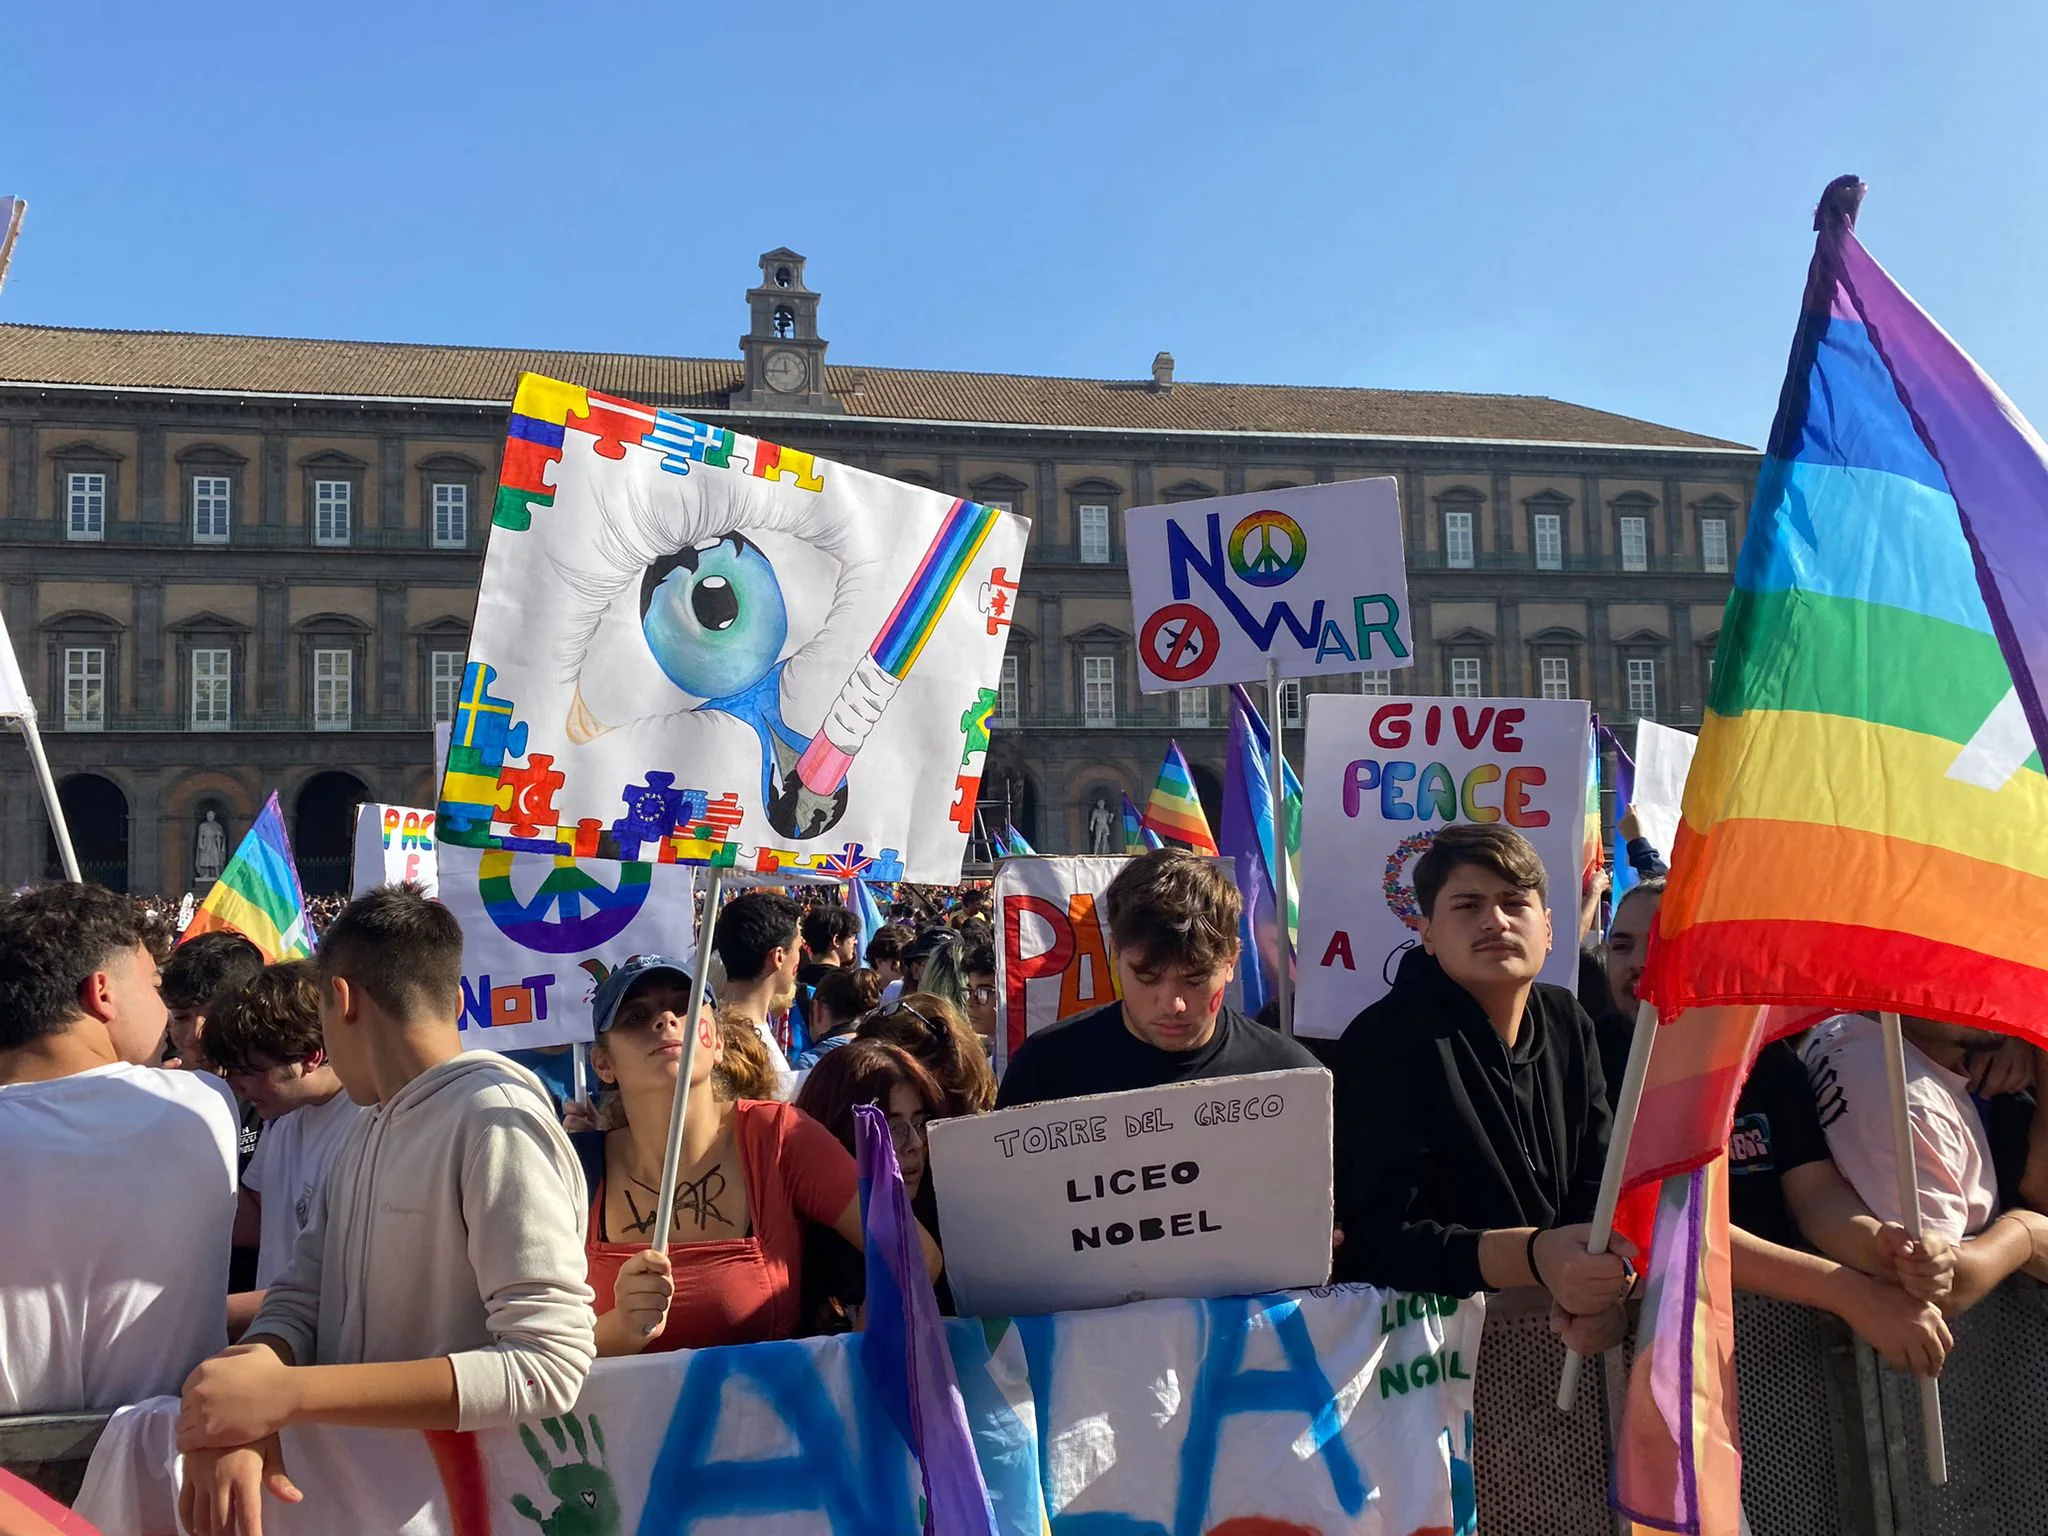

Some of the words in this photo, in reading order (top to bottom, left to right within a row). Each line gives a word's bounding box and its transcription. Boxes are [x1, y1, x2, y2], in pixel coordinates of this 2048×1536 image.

[1222, 592, 1410, 665] WAR
[1369, 702, 1526, 753] GIVE
[1342, 759, 1551, 828] PEACE
[1003, 893, 1124, 1064] PA
[1319, 930, 1357, 971] A
[458, 973, 556, 1032] NOT
[993, 1115, 1108, 1158] TORRE
[1124, 1107, 1174, 1138] DEL
[1194, 1094, 1285, 1127] GRECO
[1066, 1160, 1200, 1203] LICEO
[1071, 1210, 1223, 1252] NOBEL
